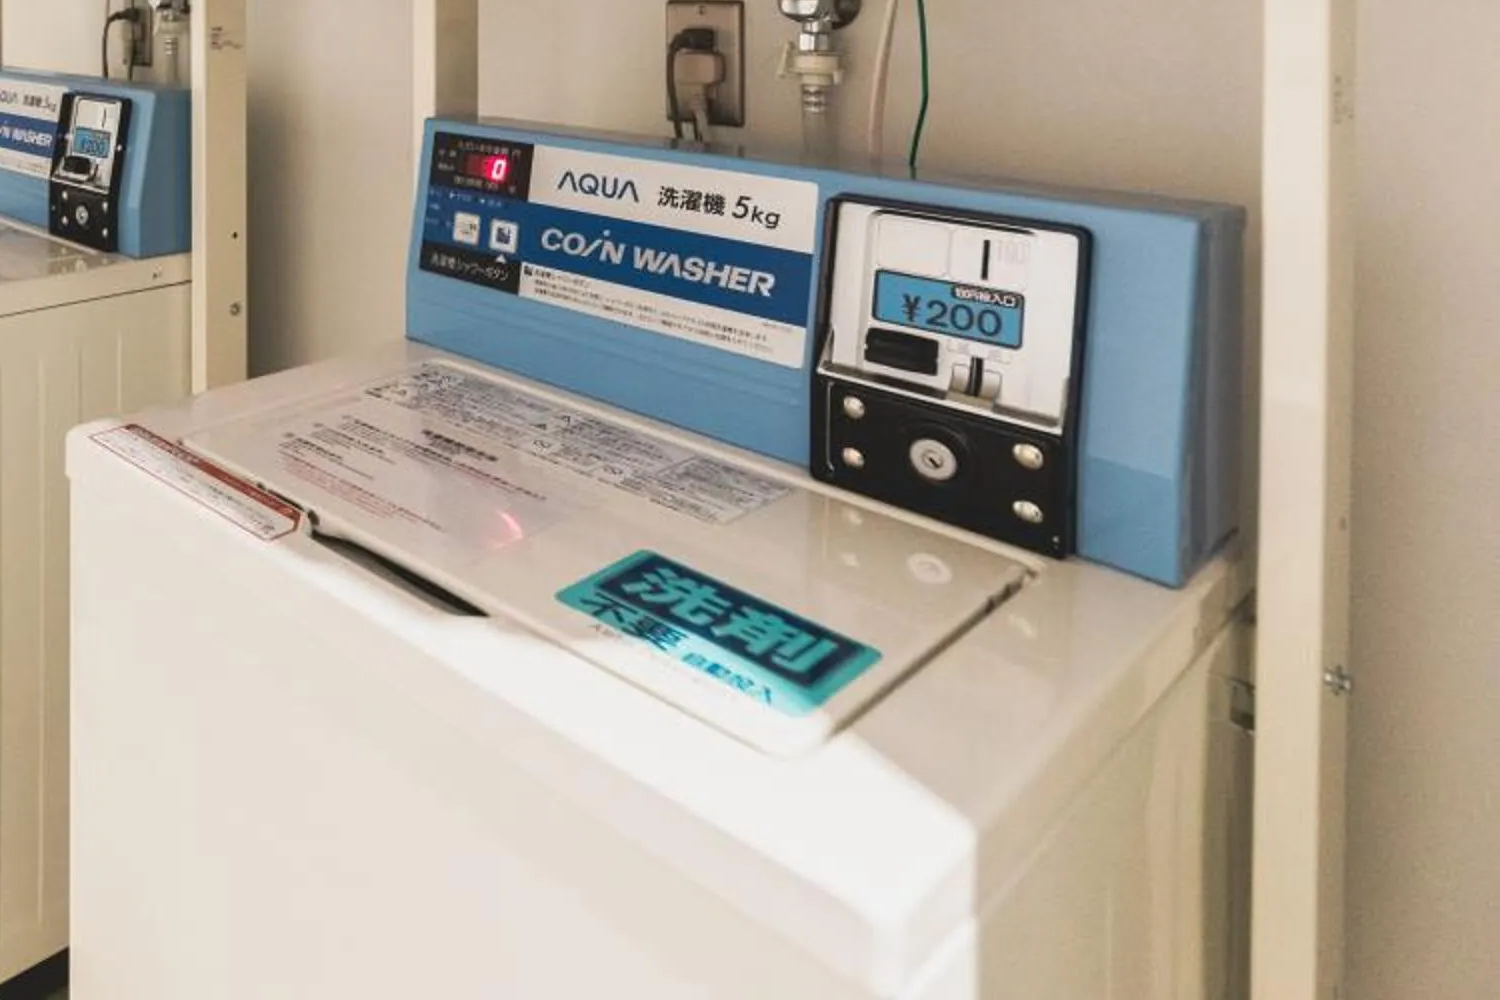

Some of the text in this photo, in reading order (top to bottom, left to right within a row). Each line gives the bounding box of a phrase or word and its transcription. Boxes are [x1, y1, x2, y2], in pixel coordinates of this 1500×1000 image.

[491, 158, 507, 181] 0
[557, 170, 640, 203] AQUA
[657, 185, 726, 217] 洗濯機
[732, 195, 782, 230] 5kg
[541, 229, 626, 265] COIN
[633, 246, 776, 298] WASHER
[902, 293, 1003, 337] ¥200
[623, 566, 838, 673] 洗剤
